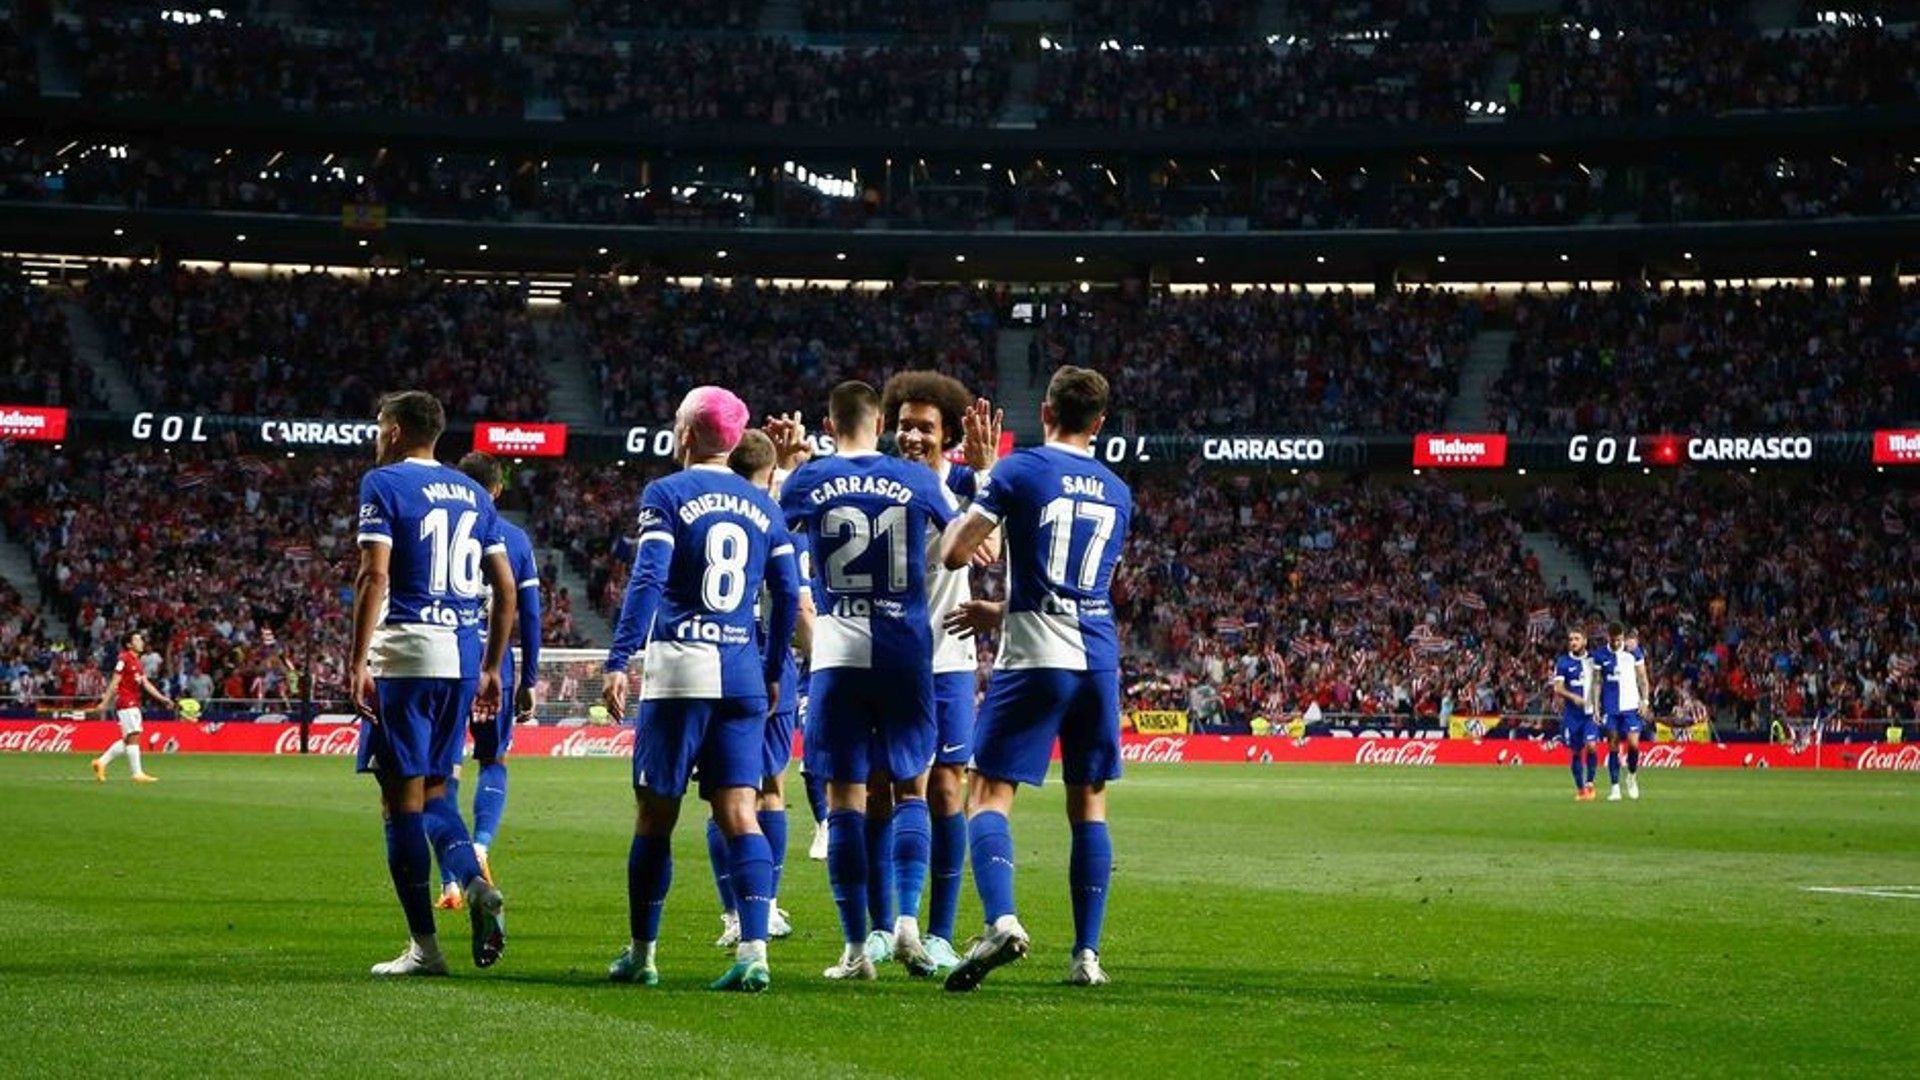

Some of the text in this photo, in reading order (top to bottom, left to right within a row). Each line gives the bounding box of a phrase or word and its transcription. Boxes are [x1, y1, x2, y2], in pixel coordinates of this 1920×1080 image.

[0, 410, 45, 428] ahou
[132, 412, 381, 445] GOL CARRASCO
[626, 427, 674, 456] GO
[1203, 438, 1324, 461] CARRASCO
[1568, 435, 1813, 464] GOL CARRASCO
[810, 475, 913, 505] CARRASCO
[1061, 475, 1106, 499] SAÚL
[679, 493, 771, 533] GRIEZMANN
[420, 508, 482, 598] 16
[821, 505, 908, 593] 21
[1039, 497, 1117, 591] 17
[702, 521, 749, 614] 8
[420, 599, 459, 626] ria
[677, 614, 721, 642] ria
